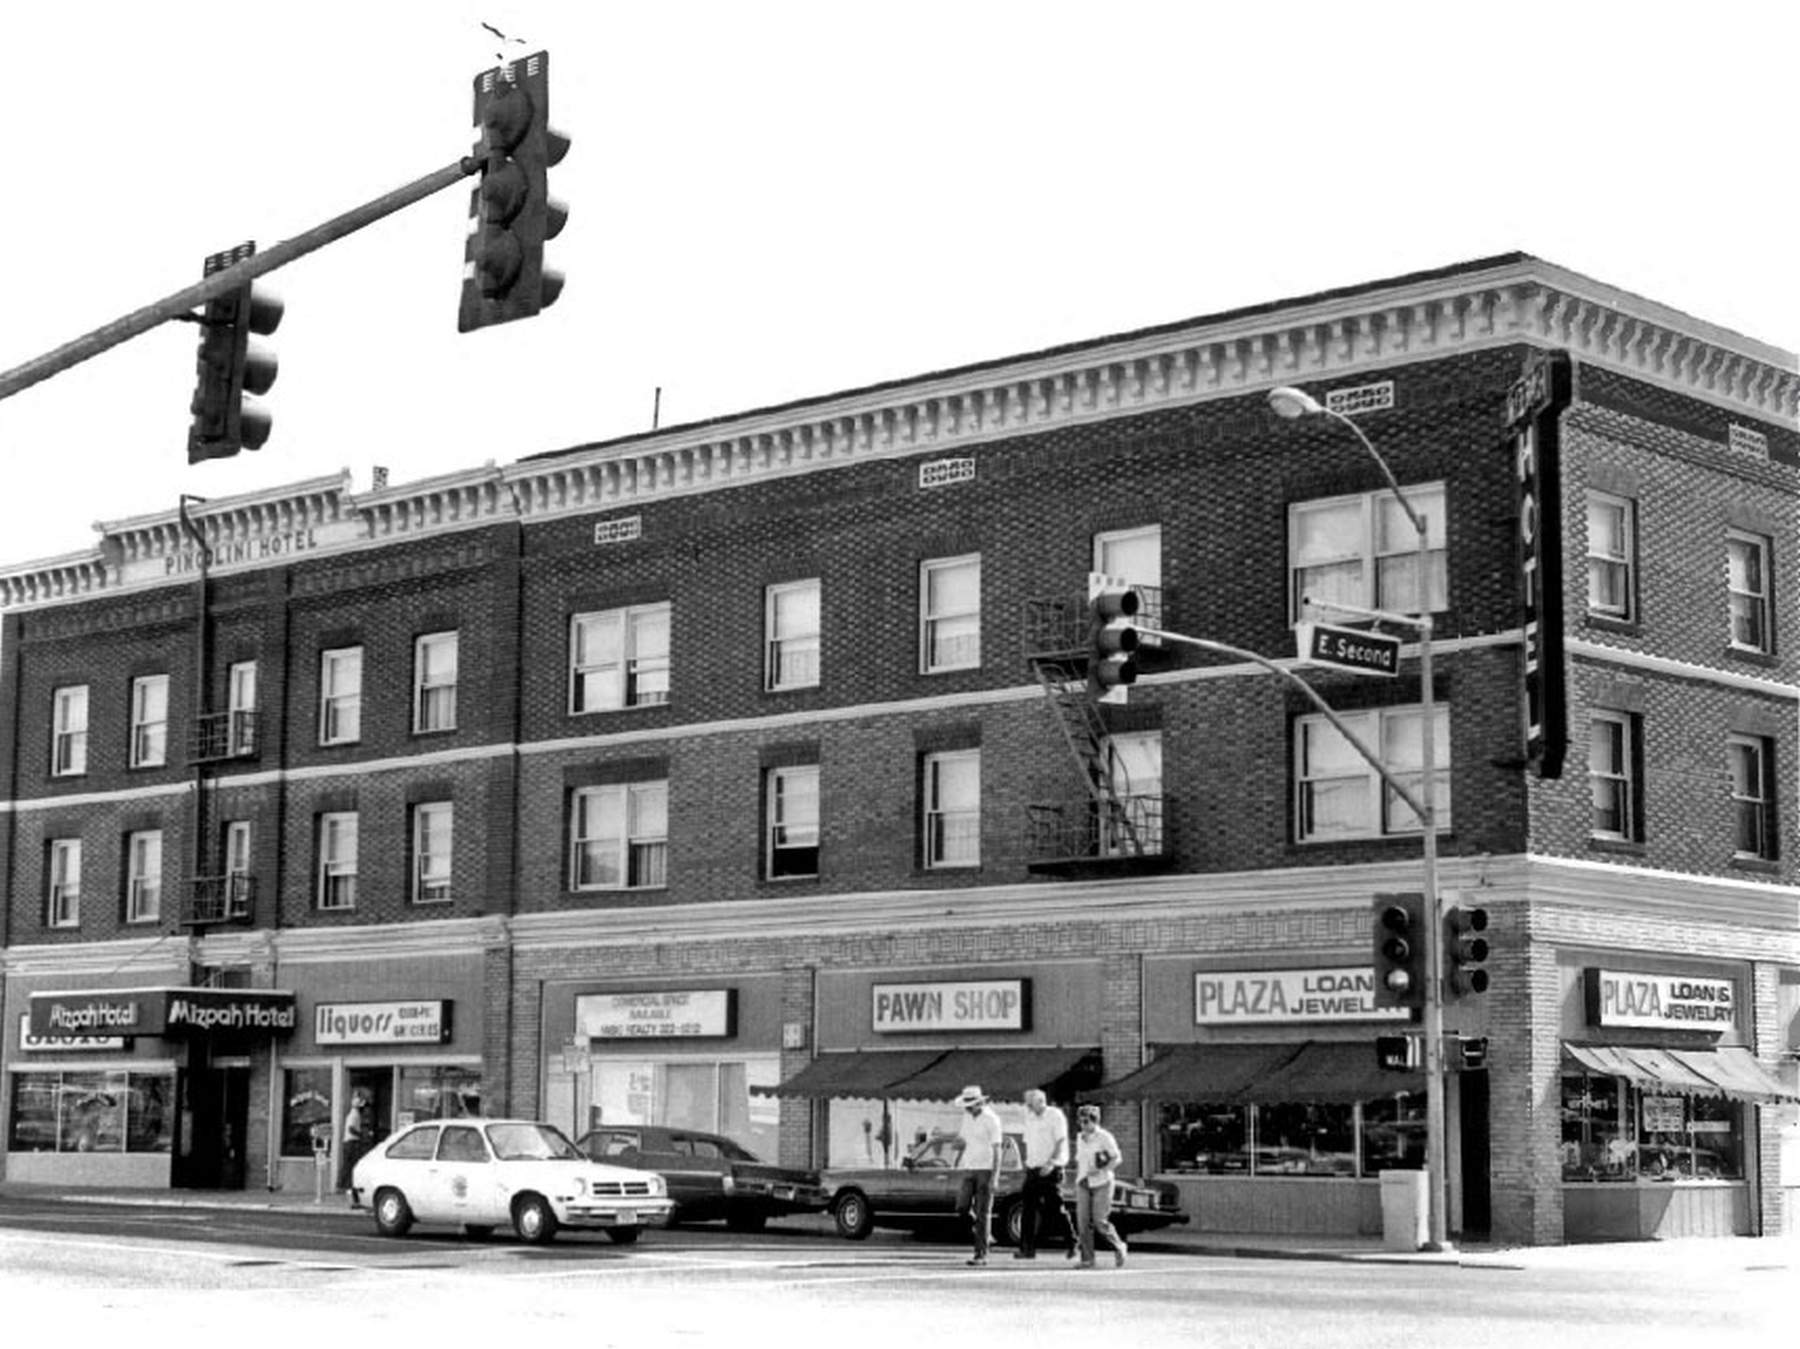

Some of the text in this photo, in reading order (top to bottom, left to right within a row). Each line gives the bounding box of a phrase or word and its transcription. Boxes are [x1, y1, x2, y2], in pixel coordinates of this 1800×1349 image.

[260, 529, 317, 555] HOTEL
[1517, 424, 1541, 743] HOTEL
[1318, 633, 1391, 667] E. Second
[169, 1000, 295, 1029] Mizpah Hotel
[876, 988, 1018, 1022] PAWN SHOP
[1200, 980, 1287, 1016] PLAZA
[1291, 997, 1405, 1014] JEWEL
[1603, 979, 1661, 1017] PLAZA
[1664, 1003, 1736, 1021] JEWELRY
[50, 1002, 138, 1030] Mizpah Hotel
[320, 1007, 392, 1040] liquors
